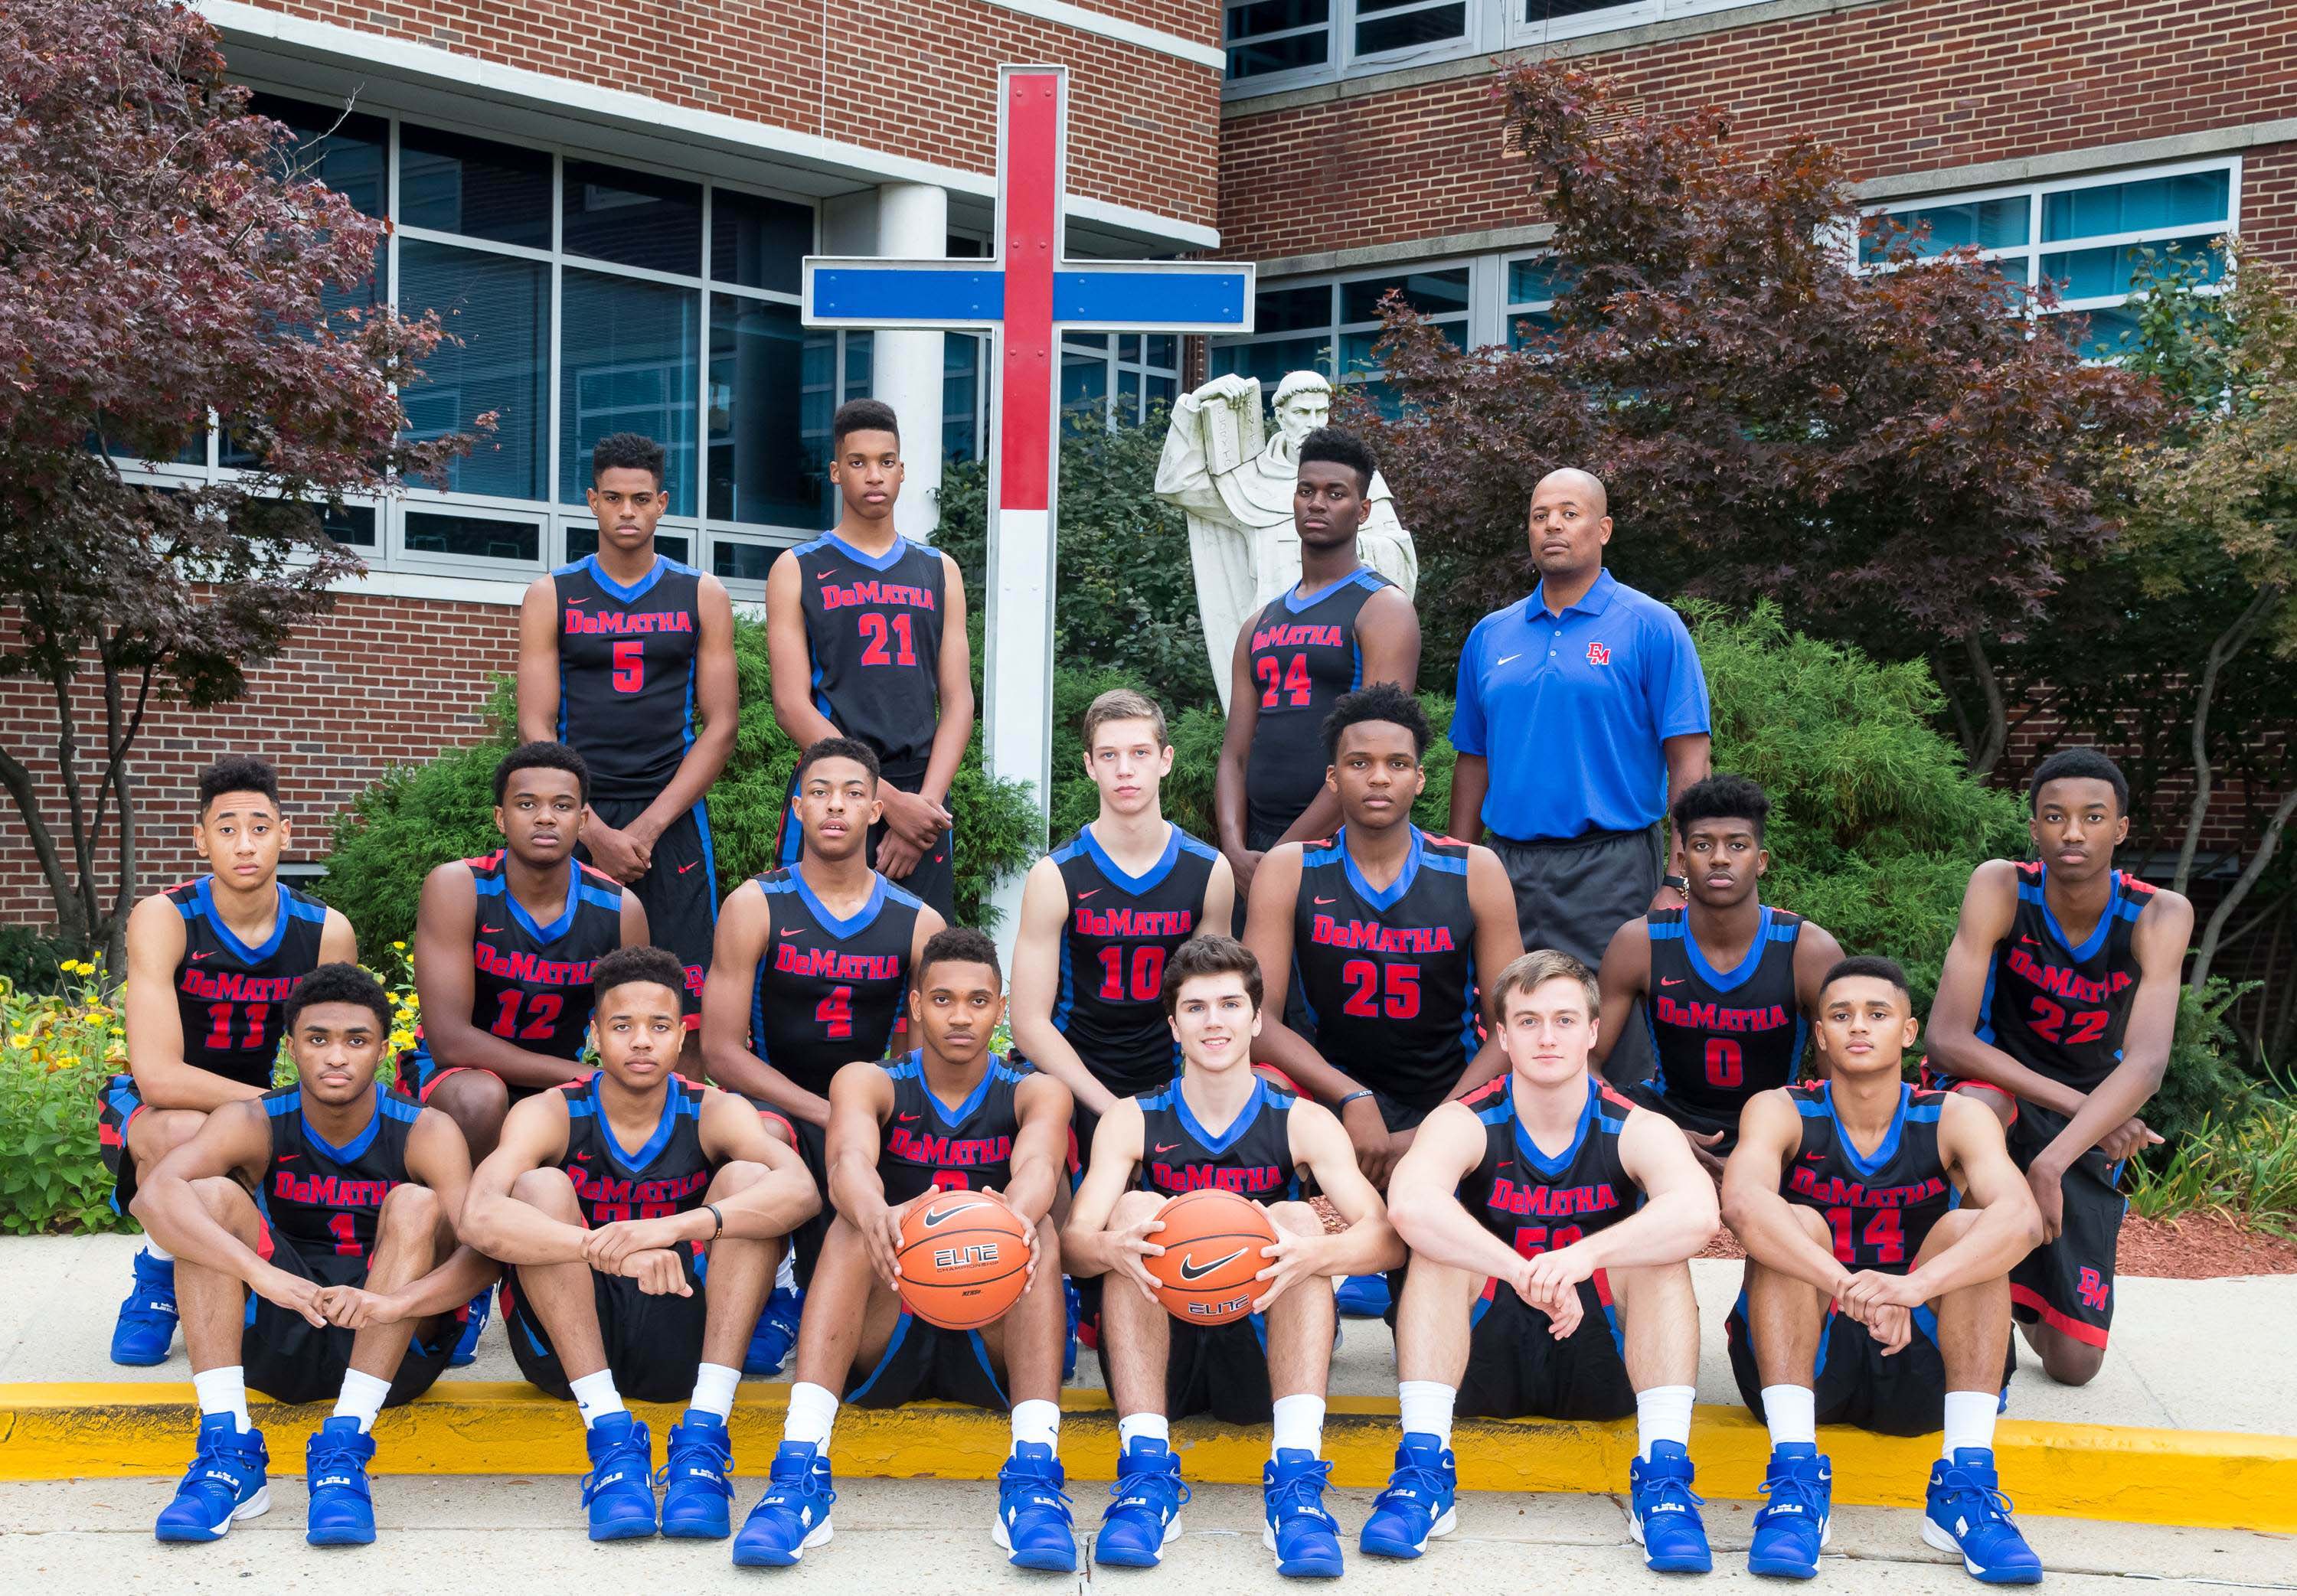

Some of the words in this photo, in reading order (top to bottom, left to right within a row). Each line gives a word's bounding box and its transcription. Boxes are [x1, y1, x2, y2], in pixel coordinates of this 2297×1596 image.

[822, 582, 935, 612] DeMATHA
[565, 609, 692, 634] DeMATHA
[858, 612, 917, 667] 21
[613, 641, 644, 693] 5
[1586, 641, 1611, 665] DM
[1256, 653, 1312, 709] 24
[1075, 908, 1192, 936] DeMATHA
[1312, 914, 1455, 954] DeMATHA
[774, 942, 900, 980] DeMATHA
[1097, 945, 1167, 1001] 10
[180, 968, 304, 1001] DeMATH
[1342, 960, 1422, 1020] 25
[204, 1002, 270, 1049] 11
[491, 988, 564, 1040] 12
[815, 986, 854, 1040] 4
[1657, 995, 1789, 1032] DeMATHA
[2027, 996, 2110, 1046] 22
[1704, 1037, 1744, 1088] 0
[888, 1126, 1011, 1166] DeMATHA
[273, 1170, 400, 1206] DeMATH
[567, 1164, 707, 1203] DeMATHA
[1152, 1161, 1283, 1193] DeMATHA
[1487, 1177, 1619, 1217] DeMATHA
[1789, 1164, 1947, 1208] DeMATHA
[327, 1213, 364, 1256] 1
[1821, 1206, 1906, 1265] 14
[934, 1242, 998, 1268] ELITE
[936, 1260, 999, 1273] CHAMPIONSHIP
[1188, 1293, 1250, 1315] ELITE
[2078, 1266, 2109, 1310] DM
